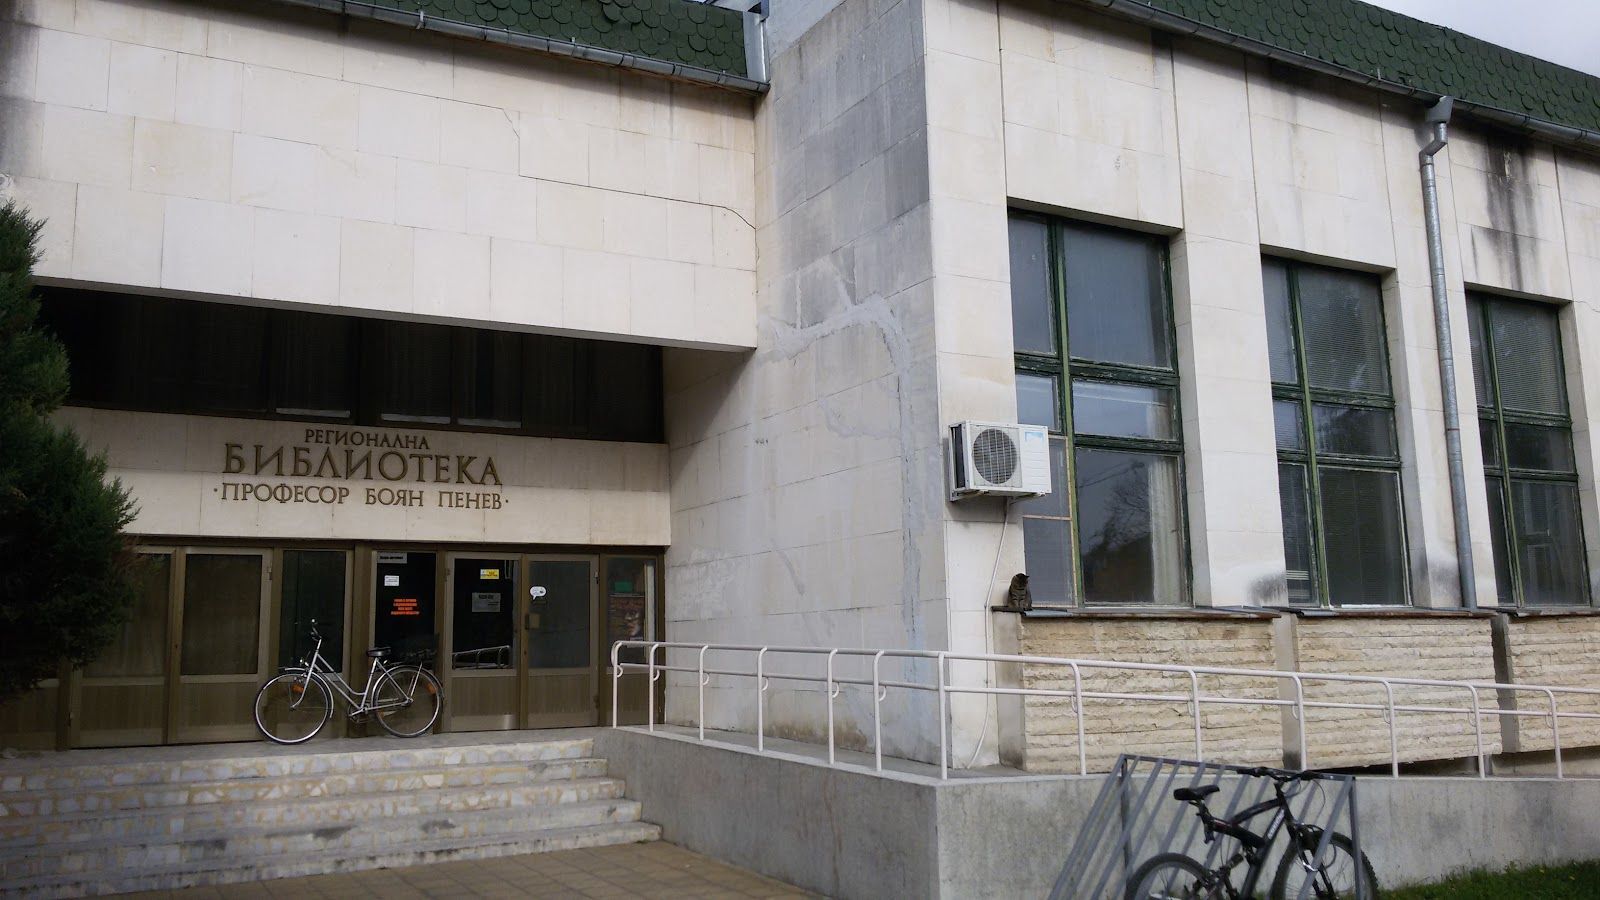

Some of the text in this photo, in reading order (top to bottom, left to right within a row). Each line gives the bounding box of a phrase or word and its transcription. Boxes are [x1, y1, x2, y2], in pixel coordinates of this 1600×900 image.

[304, 429, 430, 450] РЕГИОНАЛНА
[222, 443, 503, 486] БИБЛИОТЕКА
[221, 482, 502, 510] ПРОФЕСОР БОЯН ПЕНЕВ
